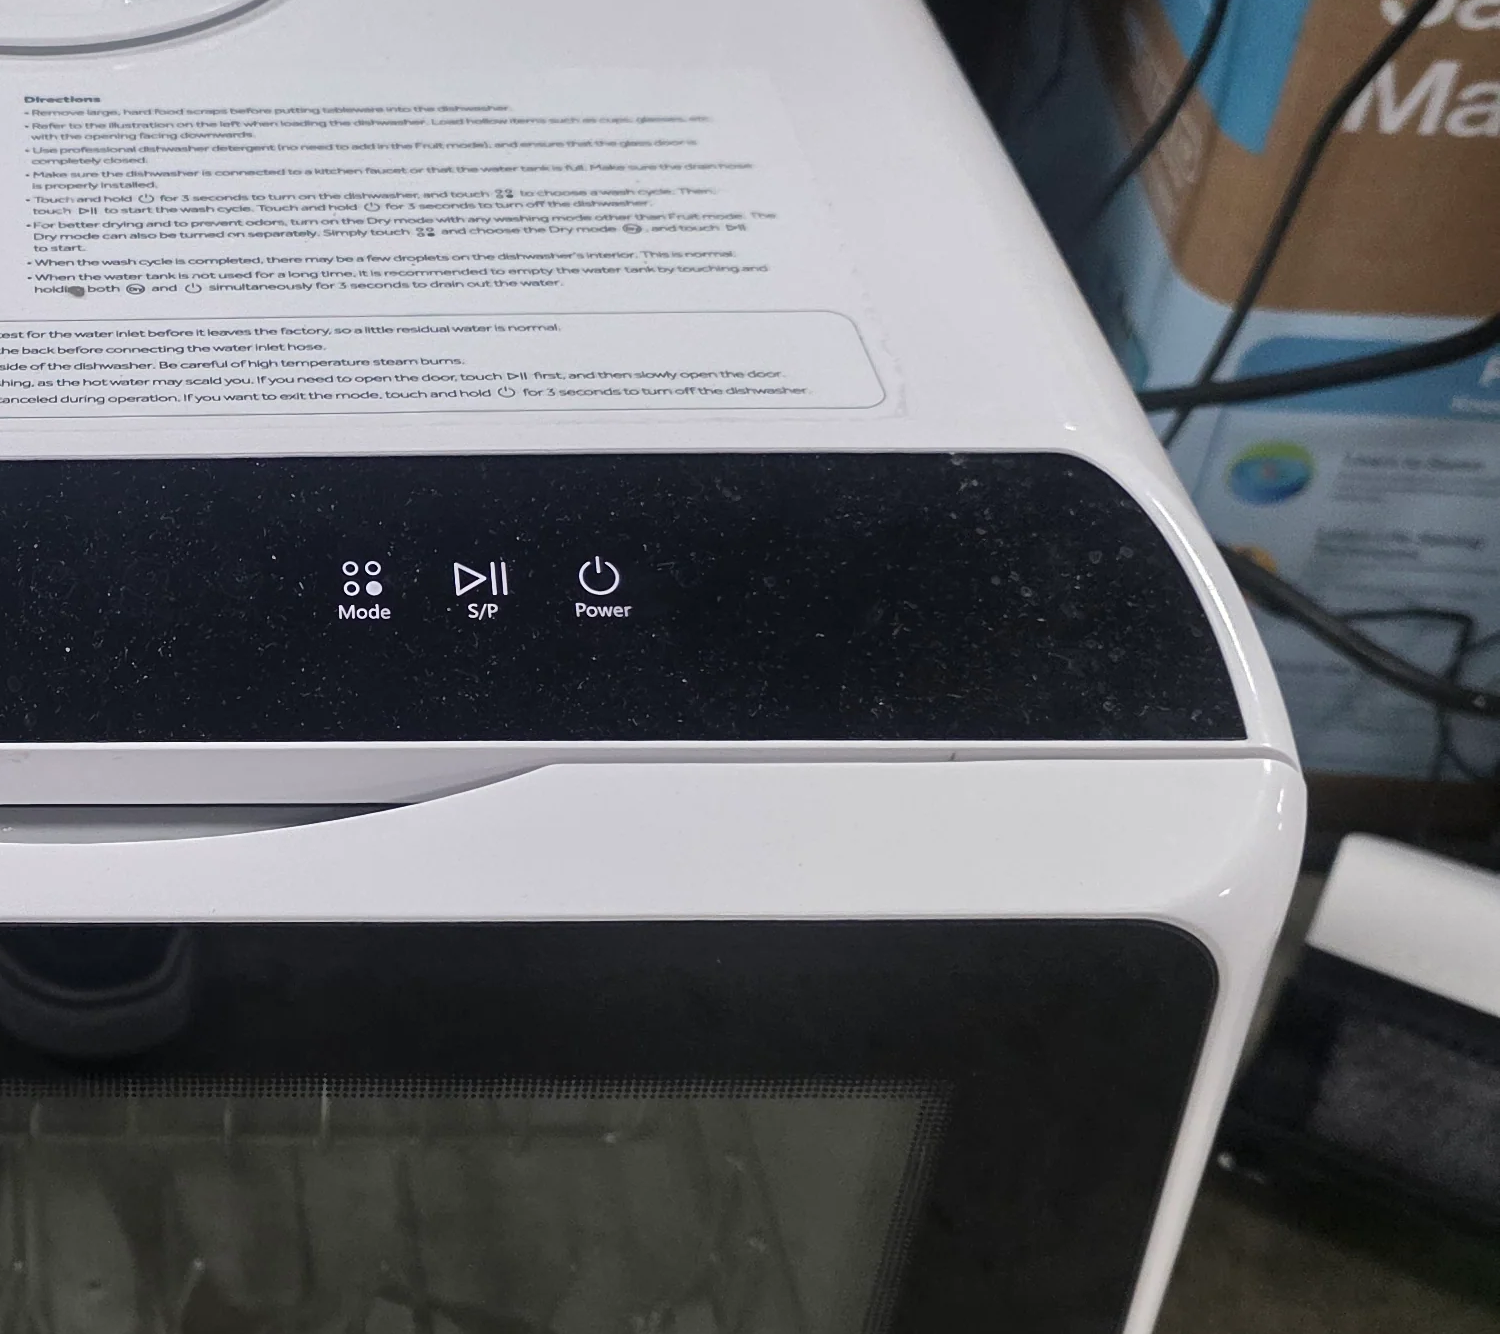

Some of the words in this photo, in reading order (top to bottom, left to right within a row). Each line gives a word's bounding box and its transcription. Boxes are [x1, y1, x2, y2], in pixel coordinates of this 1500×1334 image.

[24, 96, 101, 104] Directions
[35, 258, 75, 267] When
[76, 258, 100, 267] the
[101, 258, 137, 266] wash
[138, 257, 173, 267] cycle
[266, 256, 303, 264] there
[304, 256, 334, 265] may
[336, 255, 354, 263] be
[366, 254, 391, 262] few
[393, 254, 450, 264] droplets
[471, 253, 496, 261] the
[497, 251, 585, 260] dishwasher's
[26, 330, 47, 339] for
[48, 330, 73, 339] the
[74, 330, 114, 339] water
[116, 329, 146, 338] inlet
[147, 328, 194, 338] before
[196, 328, 206, 337] it
[207, 328, 252, 337] leaves
[254, 327, 278, 336] the
[280, 326, 332, 337] factory,
[334, 327, 352, 335] so
[364, 326, 394, 334] little
[396, 325, 450, 334] residual
[451, 324, 492, 333] water
[494, 324, 506, 332] is
[508, 323, 561, 332] normal.
[22, 346, 55, 355] back
[57, 345, 104, 355] before
[105, 345, 185, 356] connecting
[186, 344, 211, 353] the
[212, 344, 253, 352] water
[255, 343, 285, 352] inlet
[287, 342, 326, 351] hose.
[29, 362, 46, 371] of
[47, 362, 72, 371] the
[73, 361, 156, 371] dishwasher.
[159, 361, 178, 370] Be
[180, 360, 228, 370] careful
[230, 359, 247, 368] of
[248, 359, 278, 370] high
[280, 358, 370, 369] temperature
[372, 358, 419, 366] steam
[420, 357, 465, 366] burns.
[56, 378, 80, 387] the
[82, 378, 108, 387] hot
[109, 378, 150, 386] water
[152, 379, 183, 388] may
[185, 376, 222, 386] scald
[224, 377, 254, 387] you.
[256, 375, 267, 384] If
[268, 377, 295, 386] you
[297, 375, 334, 384] need
[336, 375, 353, 383] to
[354, 375, 392, 385] open
[394, 373, 419, 383] the
[421, 373, 458, 383] door,
[459, 372, 503, 382] touch
[533, 371, 566, 381] first,
[568, 371, 595, 380] and
[598, 371, 631, 379] then
[635, 370, 677, 381] slowly
[679, 371, 718, 380] open
[719, 370, 745, 379] the
[747, 370, 785, 378] door.
[60, 394, 105, 406] during
[108, 394, 181, 405] operation.
[183, 393, 193, 402] If
[194, 395, 221, 404] you
[223, 392, 260, 401] want
[261, 393, 278, 401] to
[279, 392, 307, 401] exit
[308, 391, 333, 400] the
[335, 390, 383, 400] mode,
[385, 390, 428, 399] touch
[430, 389, 457, 398] and
[459, 388, 492, 398] hold
[522, 387, 544, 397] for
[546, 388, 556, 397] 3
[558, 387, 622, 397] seconds
[622, 387, 640, 396] to
[641, 387, 673, 396] turn
[674, 386, 696, 395] off
[697, 386, 723, 395] the
[725, 386, 810, 395] dishwasher.
[338, 603, 391, 620] Mode
[467, 603, 499, 620] S/P
[575, 602, 632, 618] Power
